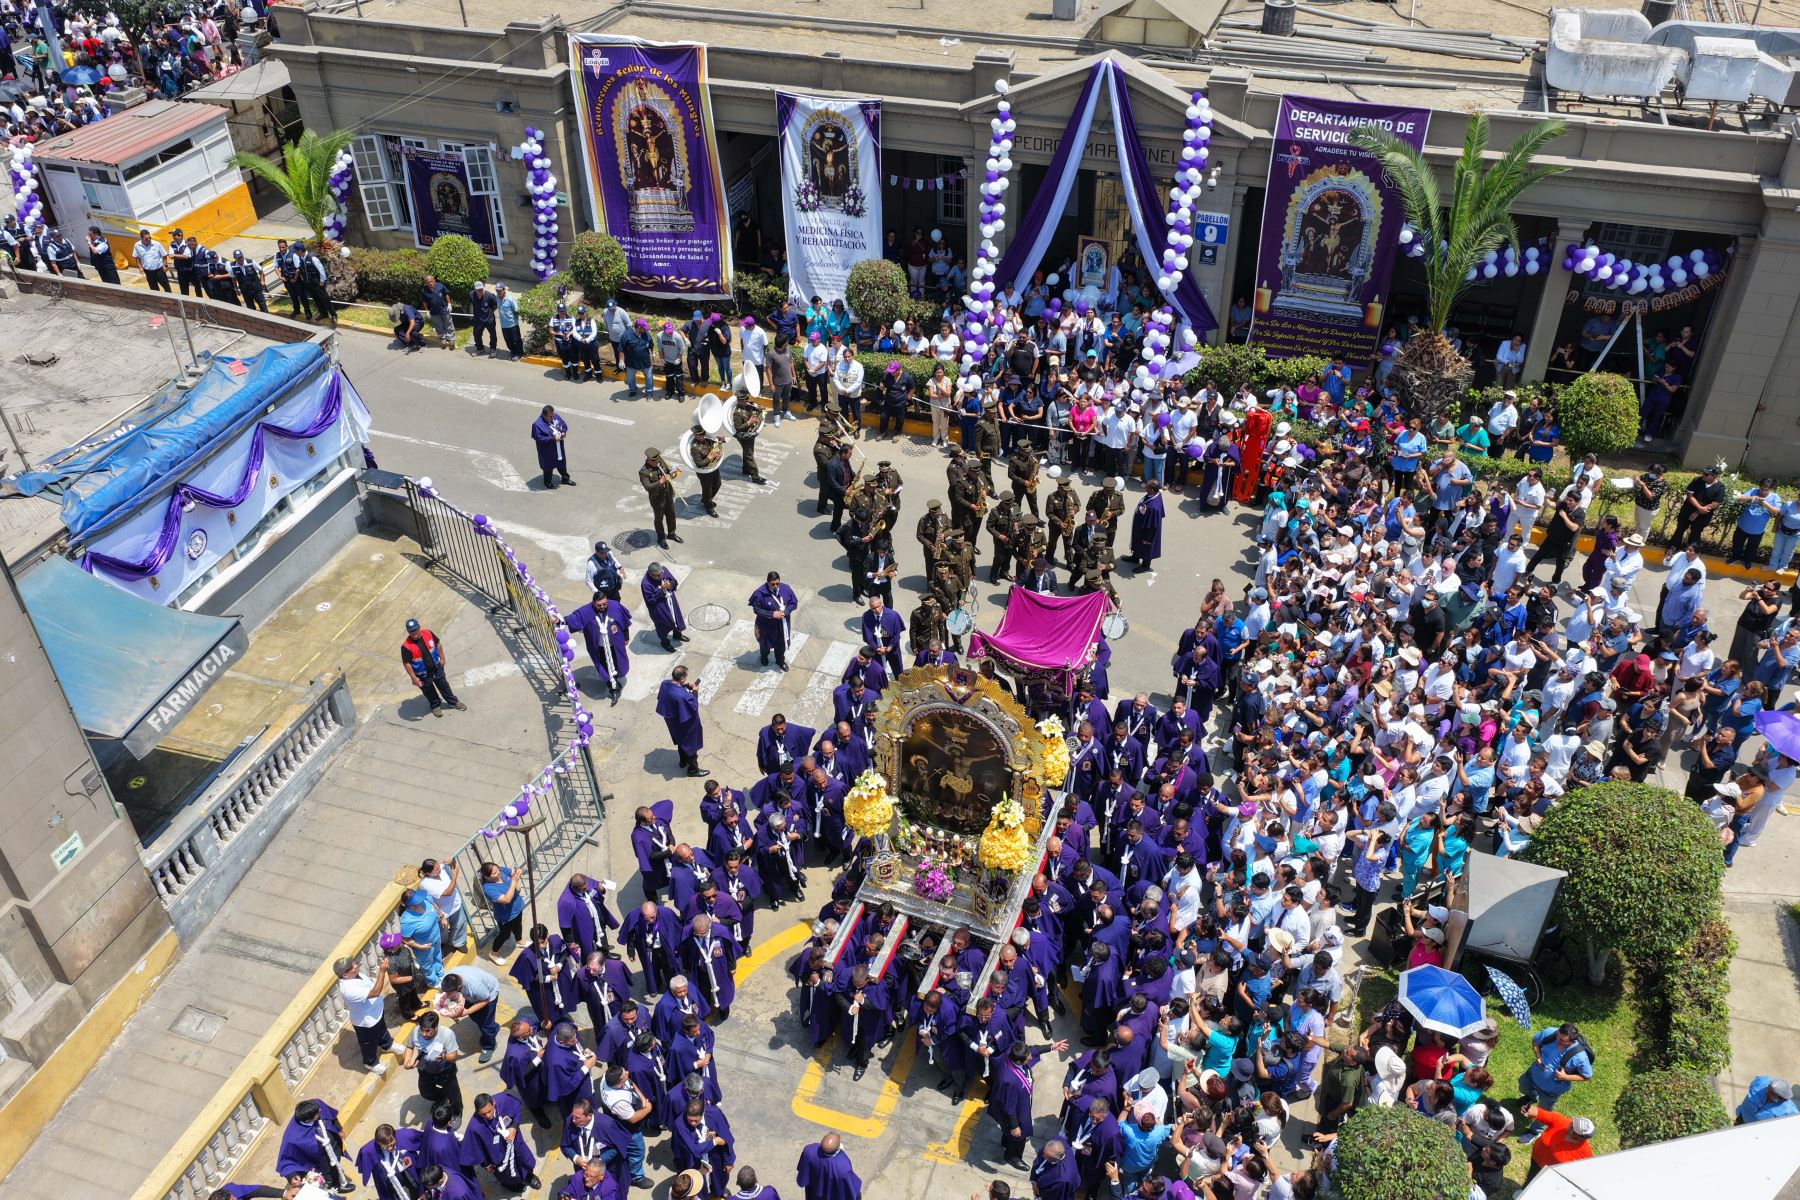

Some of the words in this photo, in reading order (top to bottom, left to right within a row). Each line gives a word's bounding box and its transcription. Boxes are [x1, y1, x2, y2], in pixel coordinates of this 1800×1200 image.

[649, 67, 663, 77] de
[664, 73, 679, 89] los
[1290, 109, 1393, 132] DEPARTAMENTO
[1396, 122, 1416, 134] DE
[1314, 146, 1348, 156] AGRADECE
[798, 225, 838, 237] MEDICINA
[840, 227, 864, 240] FÍSICA
[1205, 225, 1218, 242] 9
[795, 235, 801, 245] Y
[802, 236, 867, 251] REHABILITACIÓN
[146, 644, 236, 732] FARMACIA
